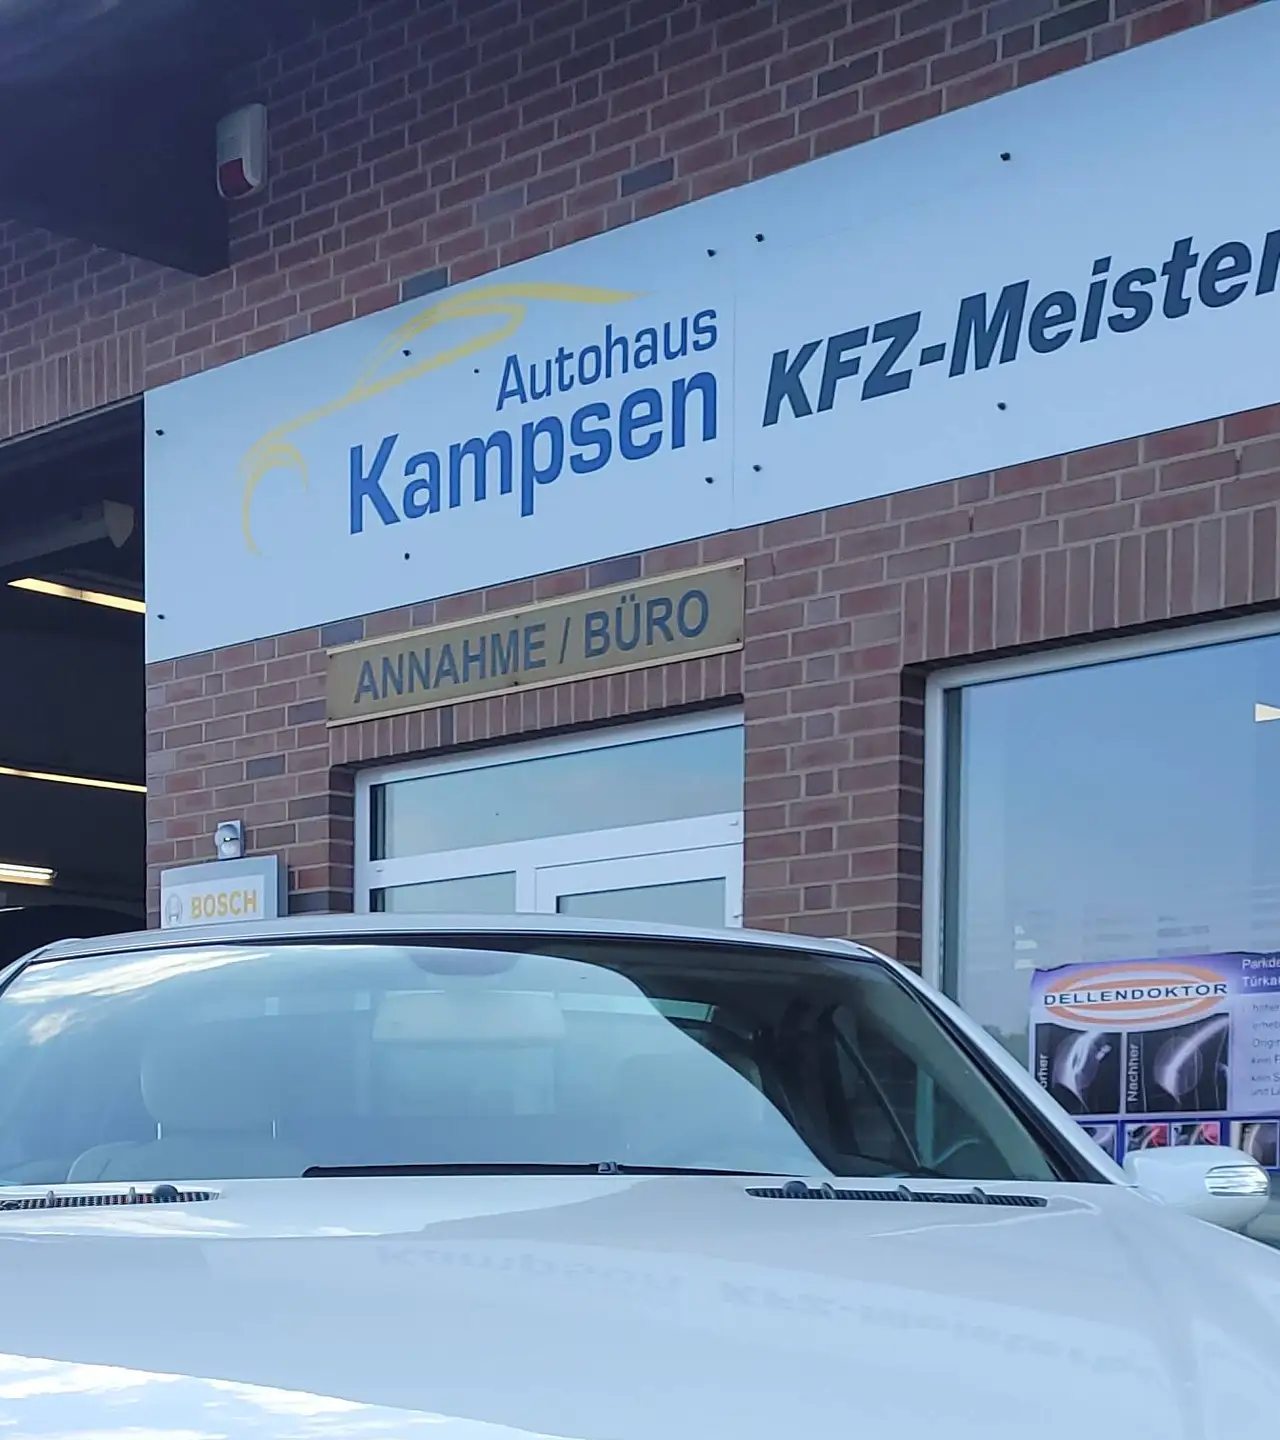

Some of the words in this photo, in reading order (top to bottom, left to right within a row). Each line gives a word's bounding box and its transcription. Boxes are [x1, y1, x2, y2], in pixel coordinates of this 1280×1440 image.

[496, 308, 718, 412] Autohaus
[350, 371, 718, 535] Kampsen
[353, 623, 546, 704] ANNAHME
[584, 589, 709, 659] BÜRO
[191, 890, 257, 919] BOSCH
[1044, 983, 1228, 1006] DELLENDOKTOR
[1037, 1054, 1049, 1090] orher
[1126, 1043, 1140, 1102] Nachher
